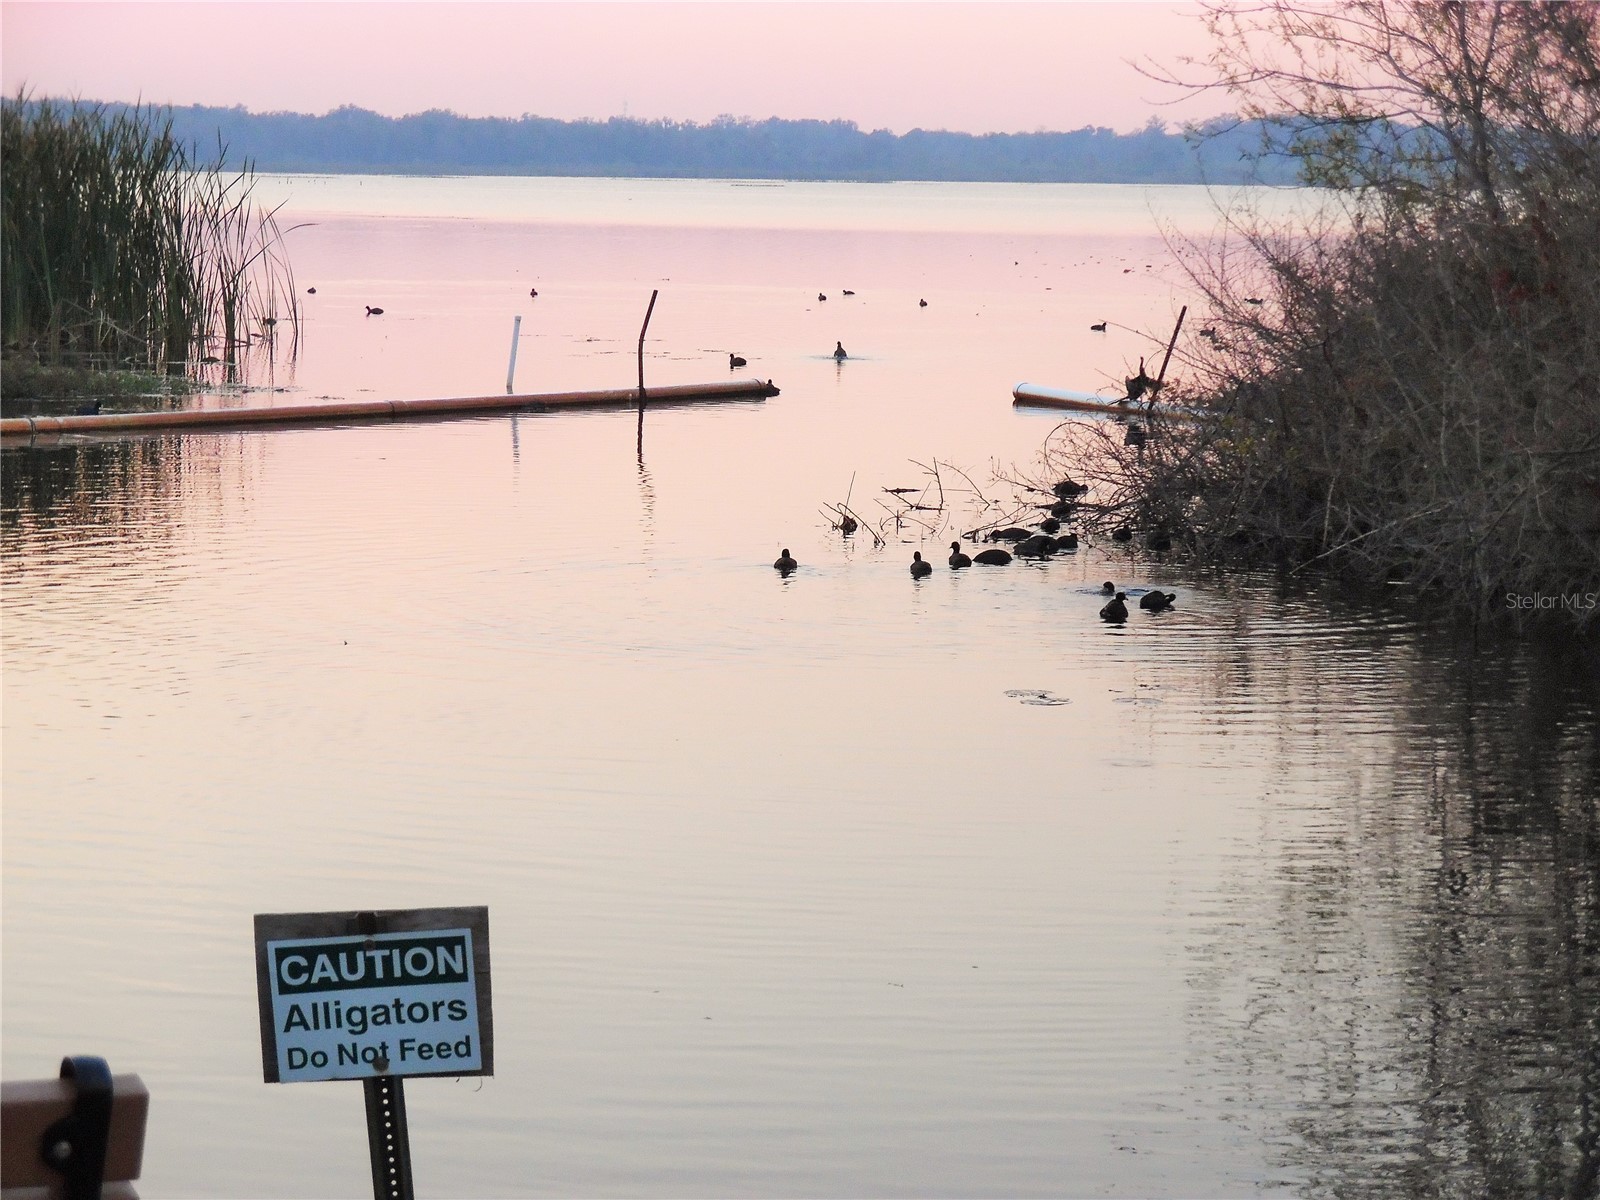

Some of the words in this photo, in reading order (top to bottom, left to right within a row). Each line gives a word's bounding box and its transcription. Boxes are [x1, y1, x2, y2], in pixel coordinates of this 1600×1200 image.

[280, 944, 465, 987] CAUTION
[283, 998, 468, 1036] Alligators
[287, 1047, 329, 1070] Do
[337, 1042, 390, 1066] Not
[399, 1035, 472, 1061] Feed
